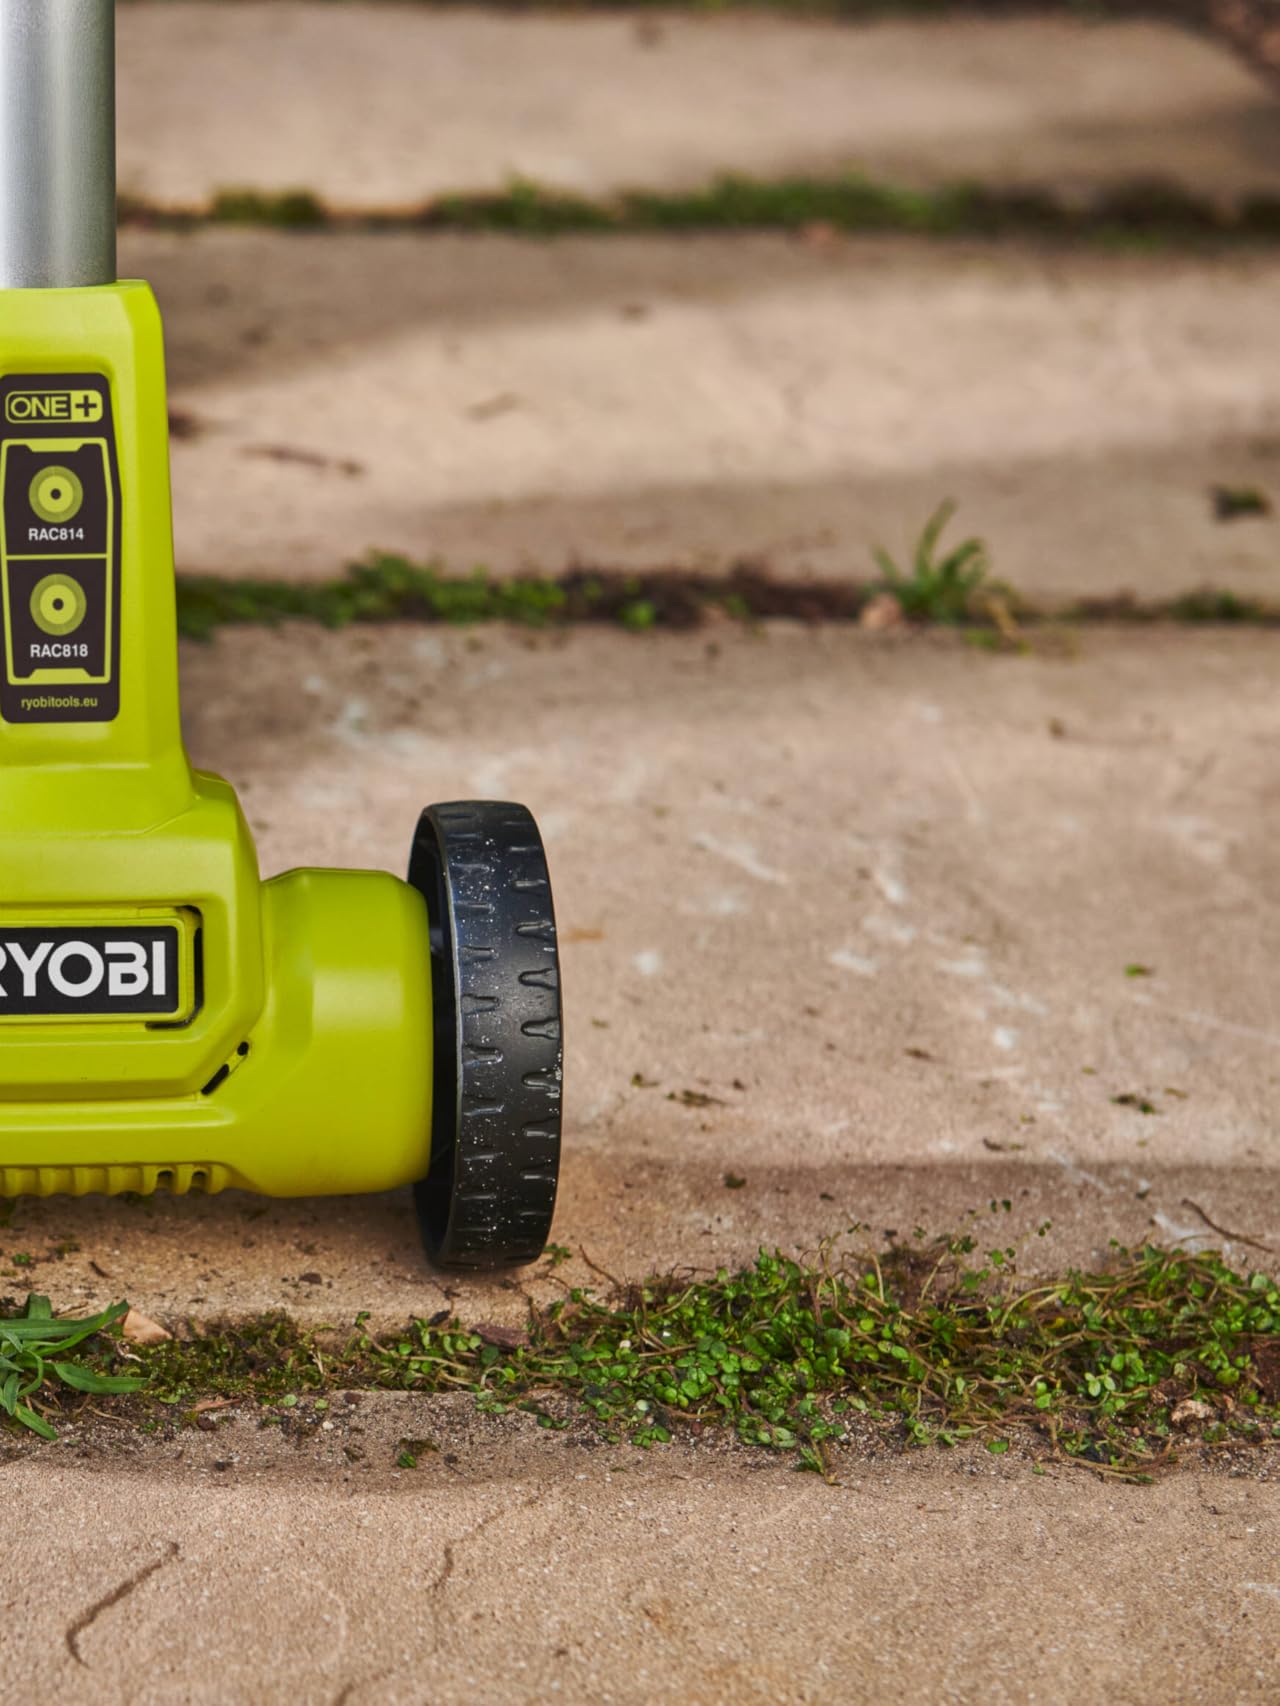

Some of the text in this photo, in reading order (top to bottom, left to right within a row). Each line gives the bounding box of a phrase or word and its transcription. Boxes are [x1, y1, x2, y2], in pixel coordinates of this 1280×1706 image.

[28, 527, 84, 542] RAC814
[30, 643, 89, 658] RAC818
[20, 696, 99, 711] ryobitools.eu
